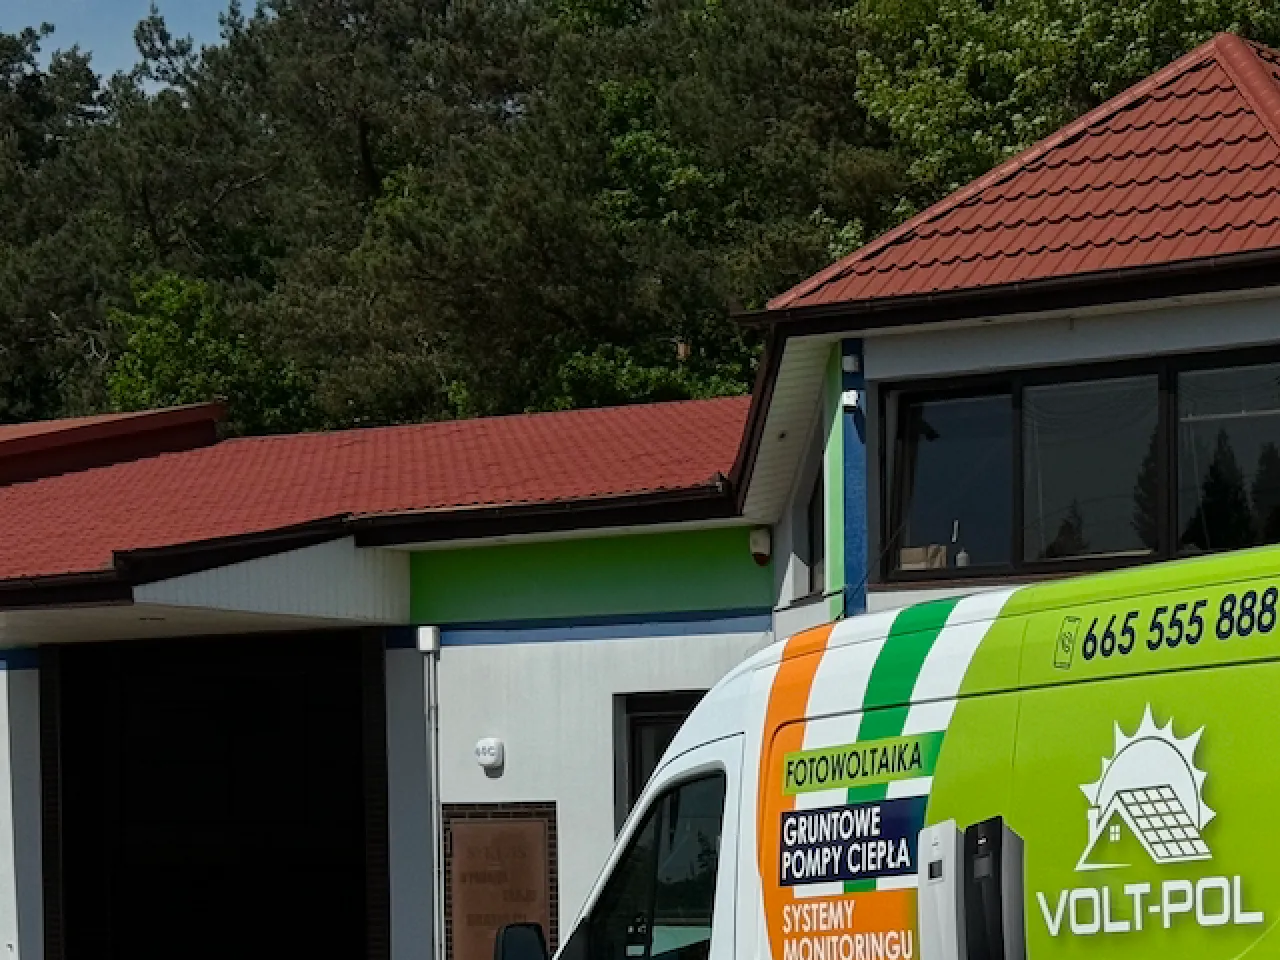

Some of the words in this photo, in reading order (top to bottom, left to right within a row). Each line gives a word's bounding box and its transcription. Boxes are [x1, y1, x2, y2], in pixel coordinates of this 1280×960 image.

[1082, 611, 1140, 661] 665
[1146, 599, 1208, 651] 555
[1215, 586, 1279, 640] 888
[785, 741, 923, 787] FOTOWOLTAIKA
[783, 807, 881, 845] GRUNTOWE
[782, 846, 842, 880] POMPY
[848, 837, 910, 873] CIEPŁA
[783, 900, 855, 934] SYSTEMY
[1037, 874, 1264, 937] VOLT-POL
